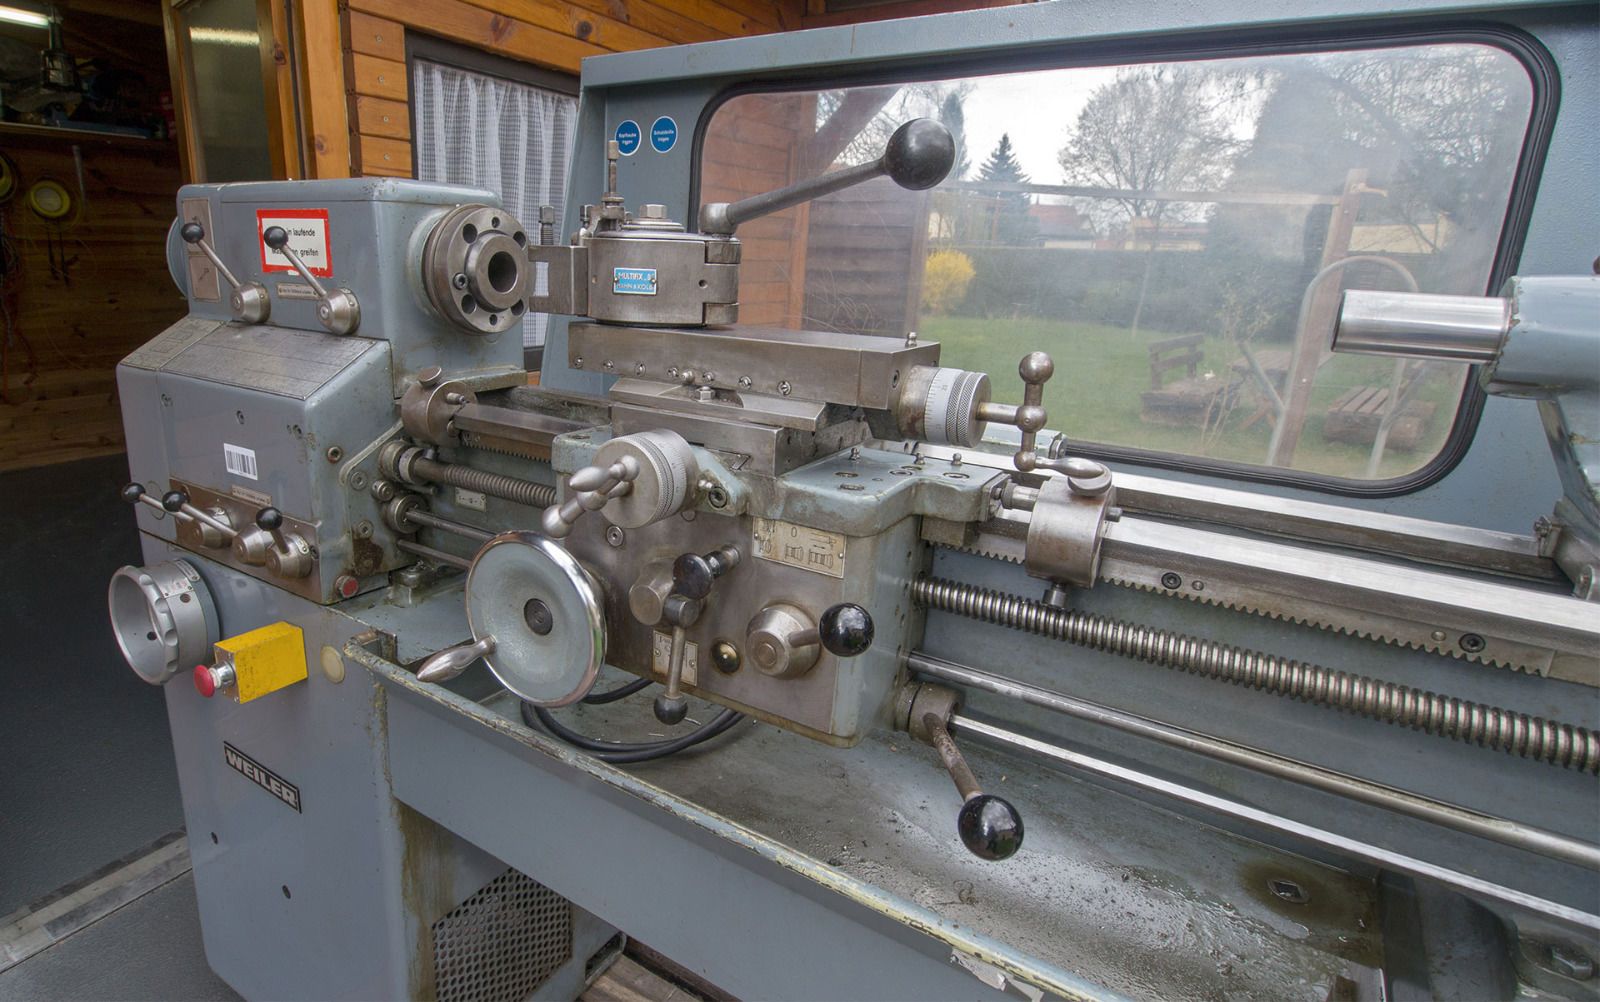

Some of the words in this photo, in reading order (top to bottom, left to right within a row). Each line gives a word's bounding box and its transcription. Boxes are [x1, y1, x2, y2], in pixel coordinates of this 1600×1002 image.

[293, 228, 315, 237] laufende
[300, 248, 318, 257] greifen
[226, 749, 297, 807] WEILER
